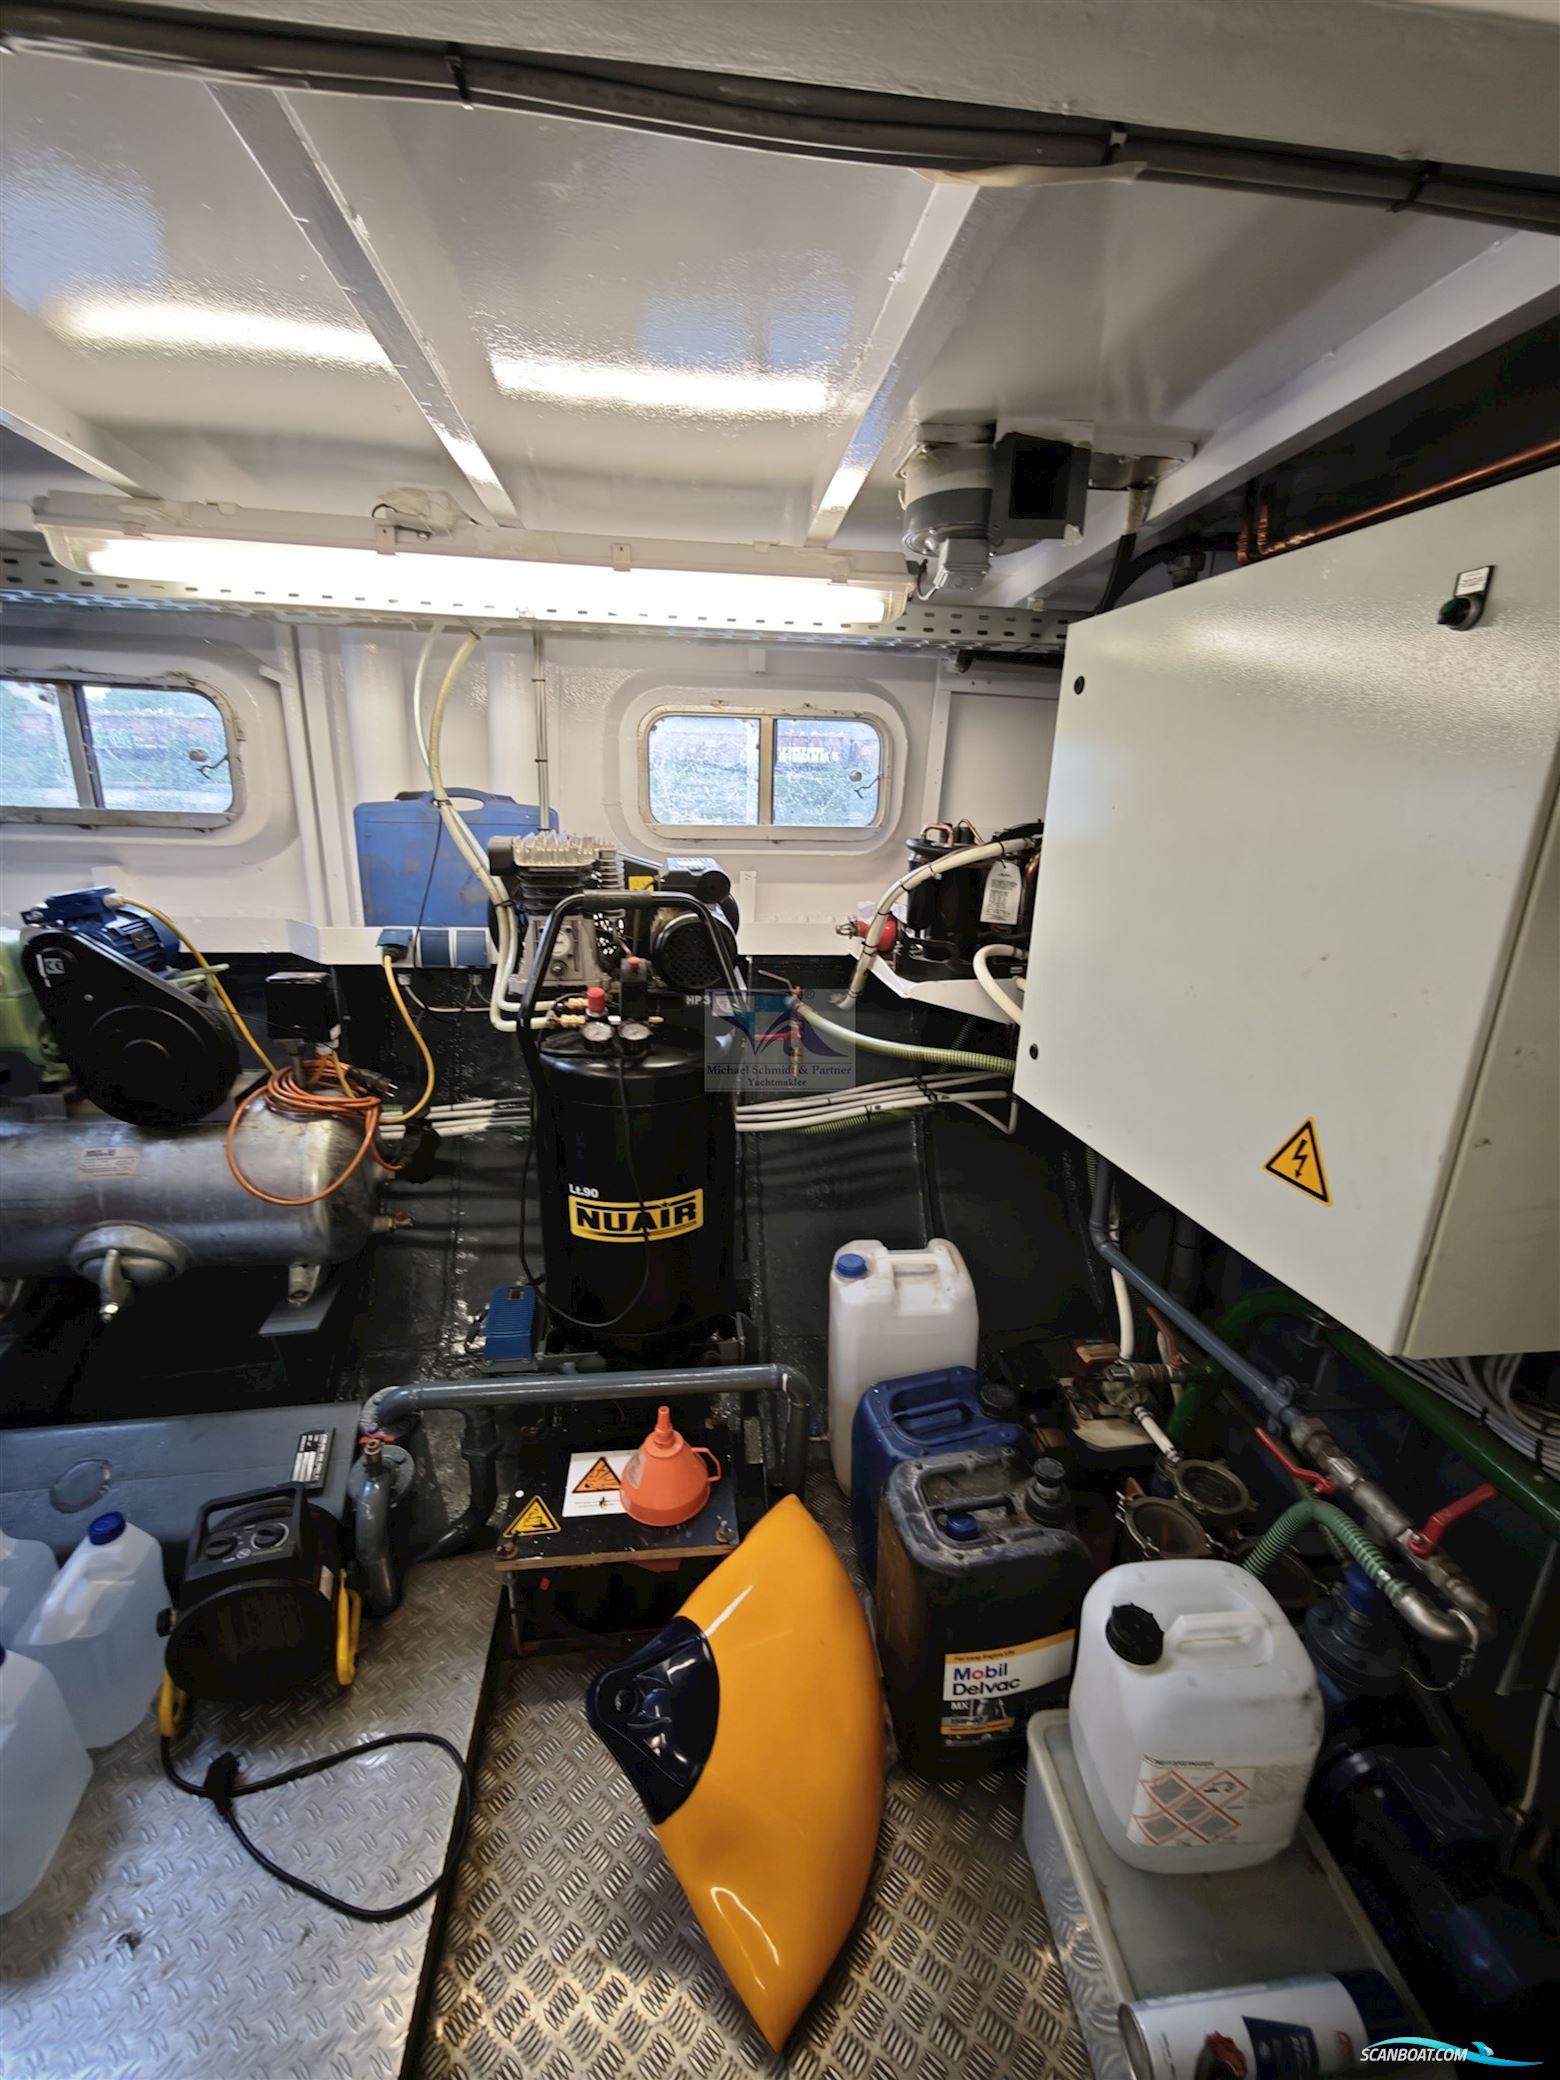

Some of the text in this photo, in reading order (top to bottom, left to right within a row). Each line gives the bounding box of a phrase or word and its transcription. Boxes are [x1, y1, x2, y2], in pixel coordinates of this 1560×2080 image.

[686, 994, 702, 1005] HP
[576, 1203, 697, 1232] NUAIR
[953, 1662, 1009, 1681] Mobil
[952, 1678, 1021, 1696] Delvac
[951, 1701, 969, 1711] MX
